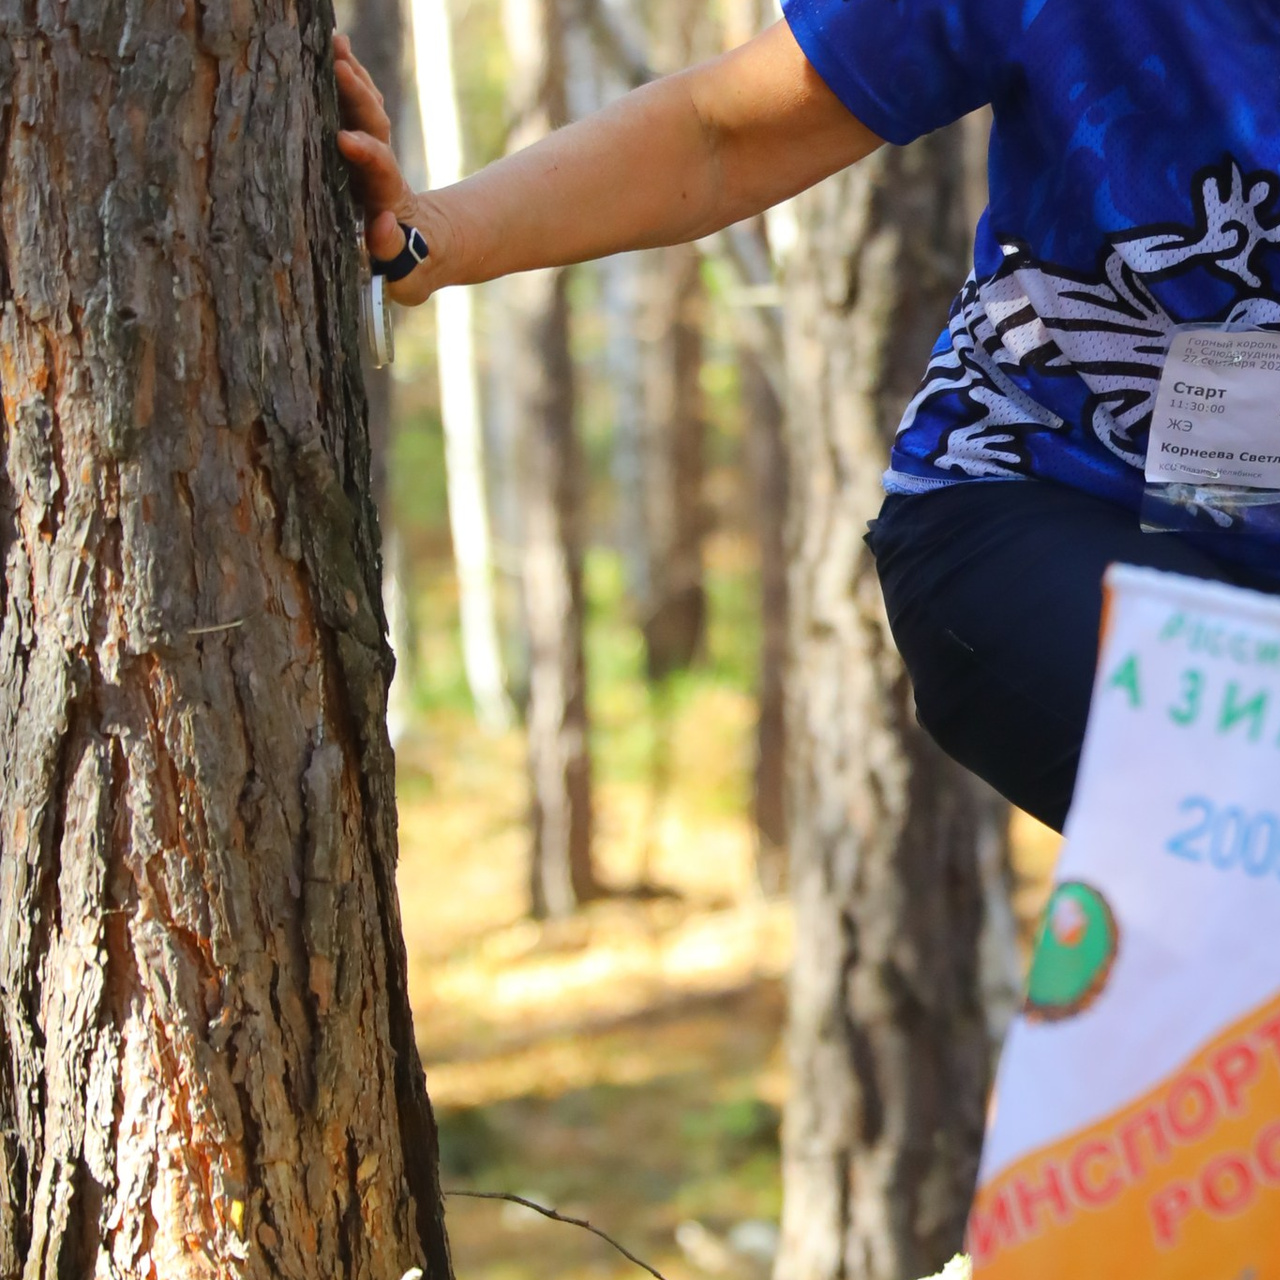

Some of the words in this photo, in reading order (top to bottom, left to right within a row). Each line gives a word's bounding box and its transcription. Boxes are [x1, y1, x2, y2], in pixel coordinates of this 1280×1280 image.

[1188, 337, 1233, 349] Горный
[1236, 340, 1279, 351] король
[1182, 354, 1198, 364] 27
[1173, 381, 1228, 400] Старт
[1169, 399, 1226, 415] 11:30:00
[1166, 418, 1193, 432] ЖЭ
[1160, 442, 1234, 460] Корнеева
